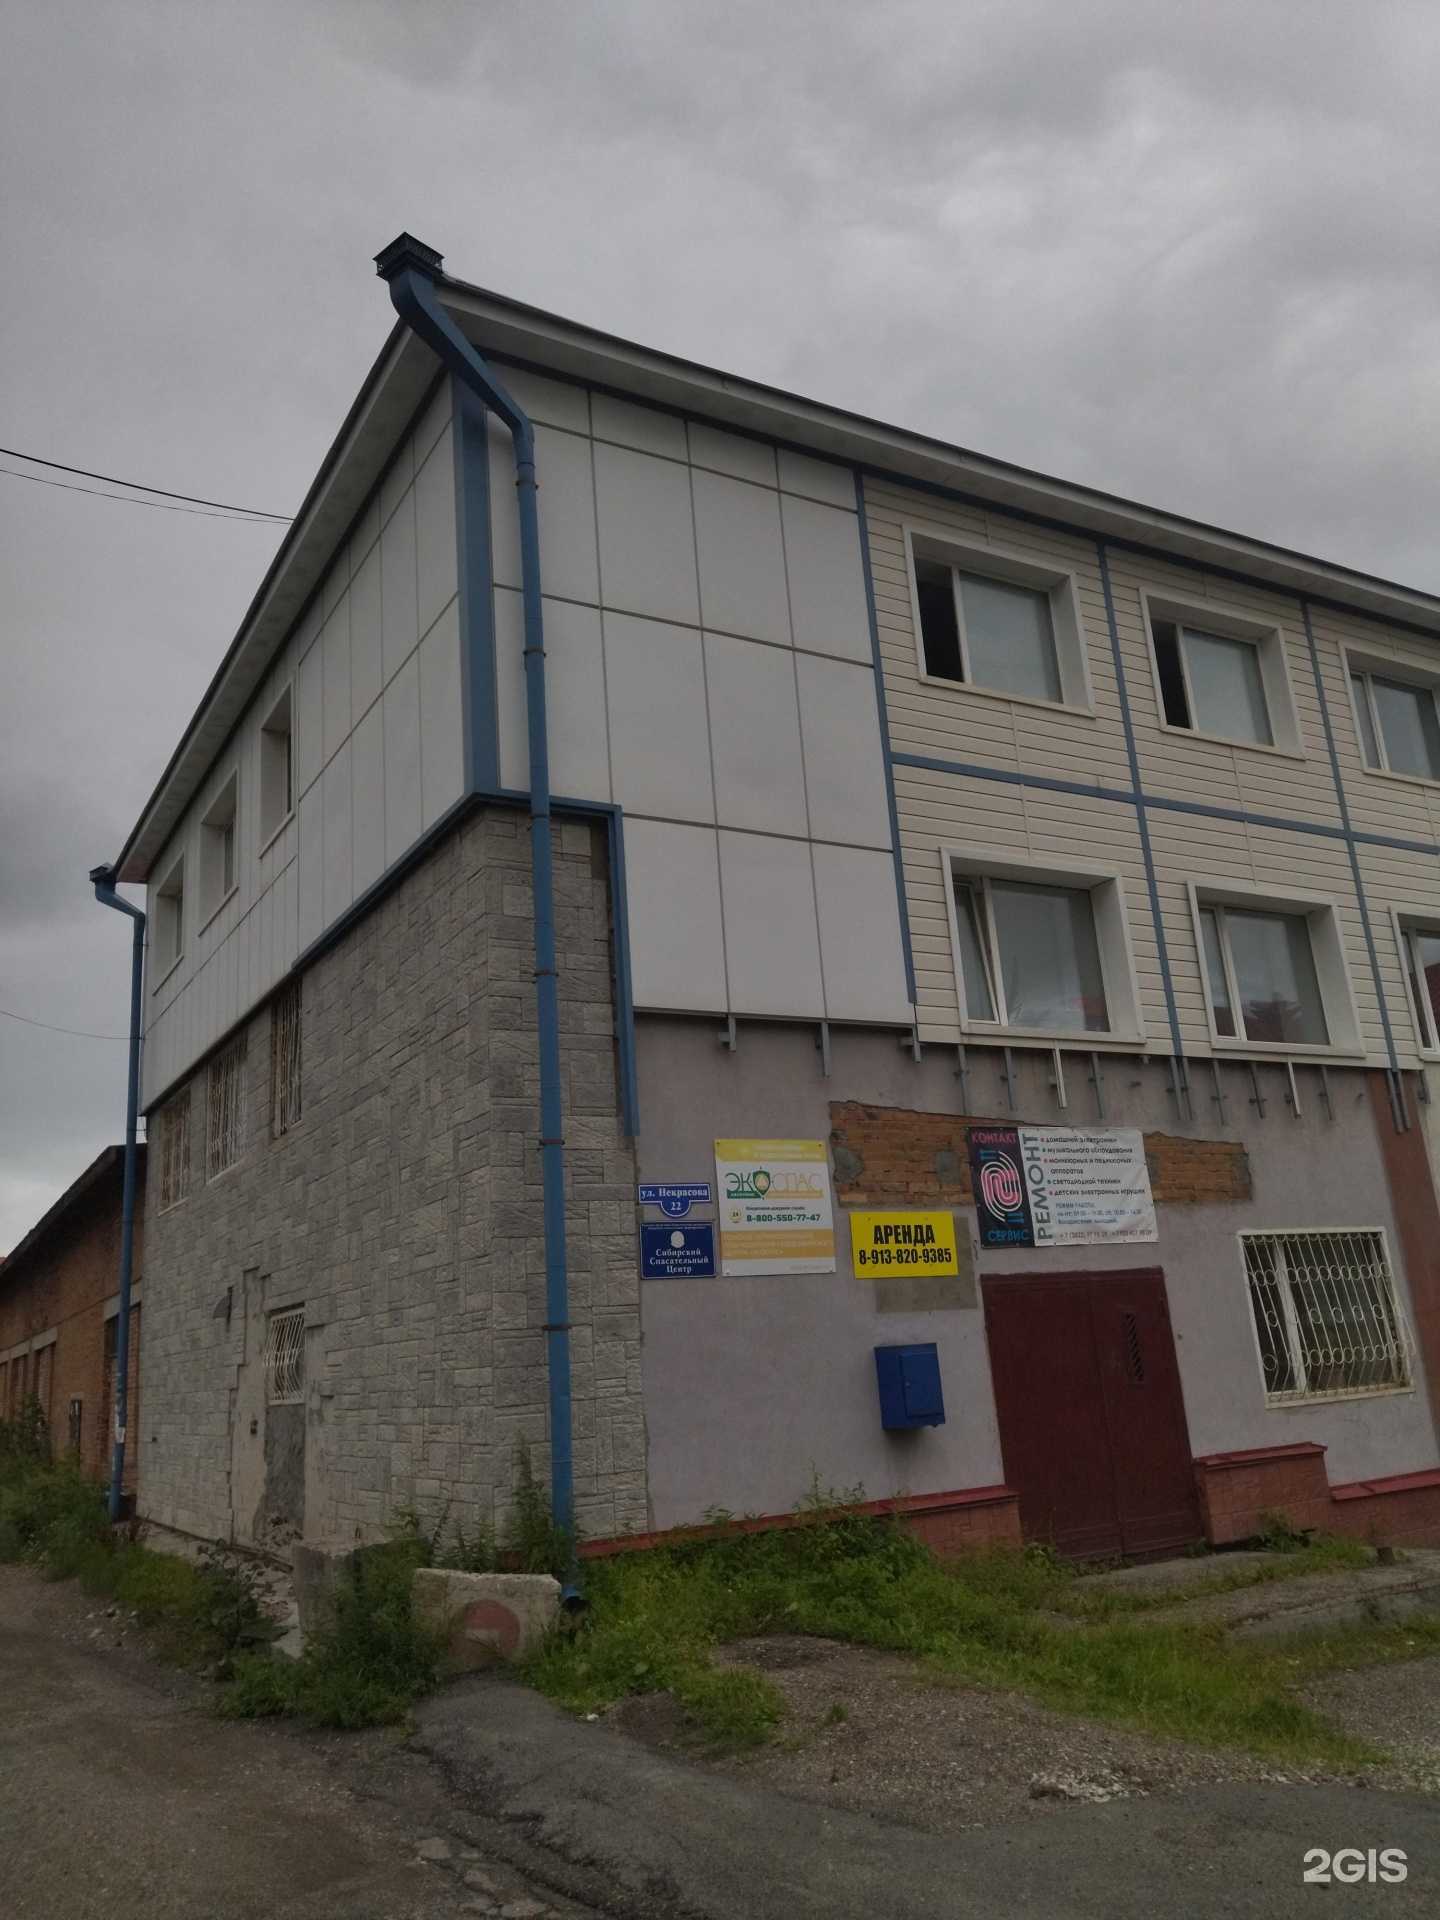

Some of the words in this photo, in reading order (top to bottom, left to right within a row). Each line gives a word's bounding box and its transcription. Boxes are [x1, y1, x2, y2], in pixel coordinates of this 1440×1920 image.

[971, 1131, 1017, 1144] КОНТАКТ
[1022, 1133, 1053, 1240] РЕМОНТ
[641, 1189, 656, 1199] ул.
[659, 1187, 708, 1198] Некрасова
[670, 1201, 682, 1210] 22
[746, 1213, 821, 1222] 8-800-550-77-47
[873, 1224, 936, 1246] АРЕНДА
[988, 1229, 1029, 1242] СЕРВИС
[655, 1247, 701, 1257] Сибирский
[858, 1247, 952, 1265] 8-913-820-9385
[649, 1256, 709, 1266] Спасательный
[666, 1266, 692, 1274] Центр
